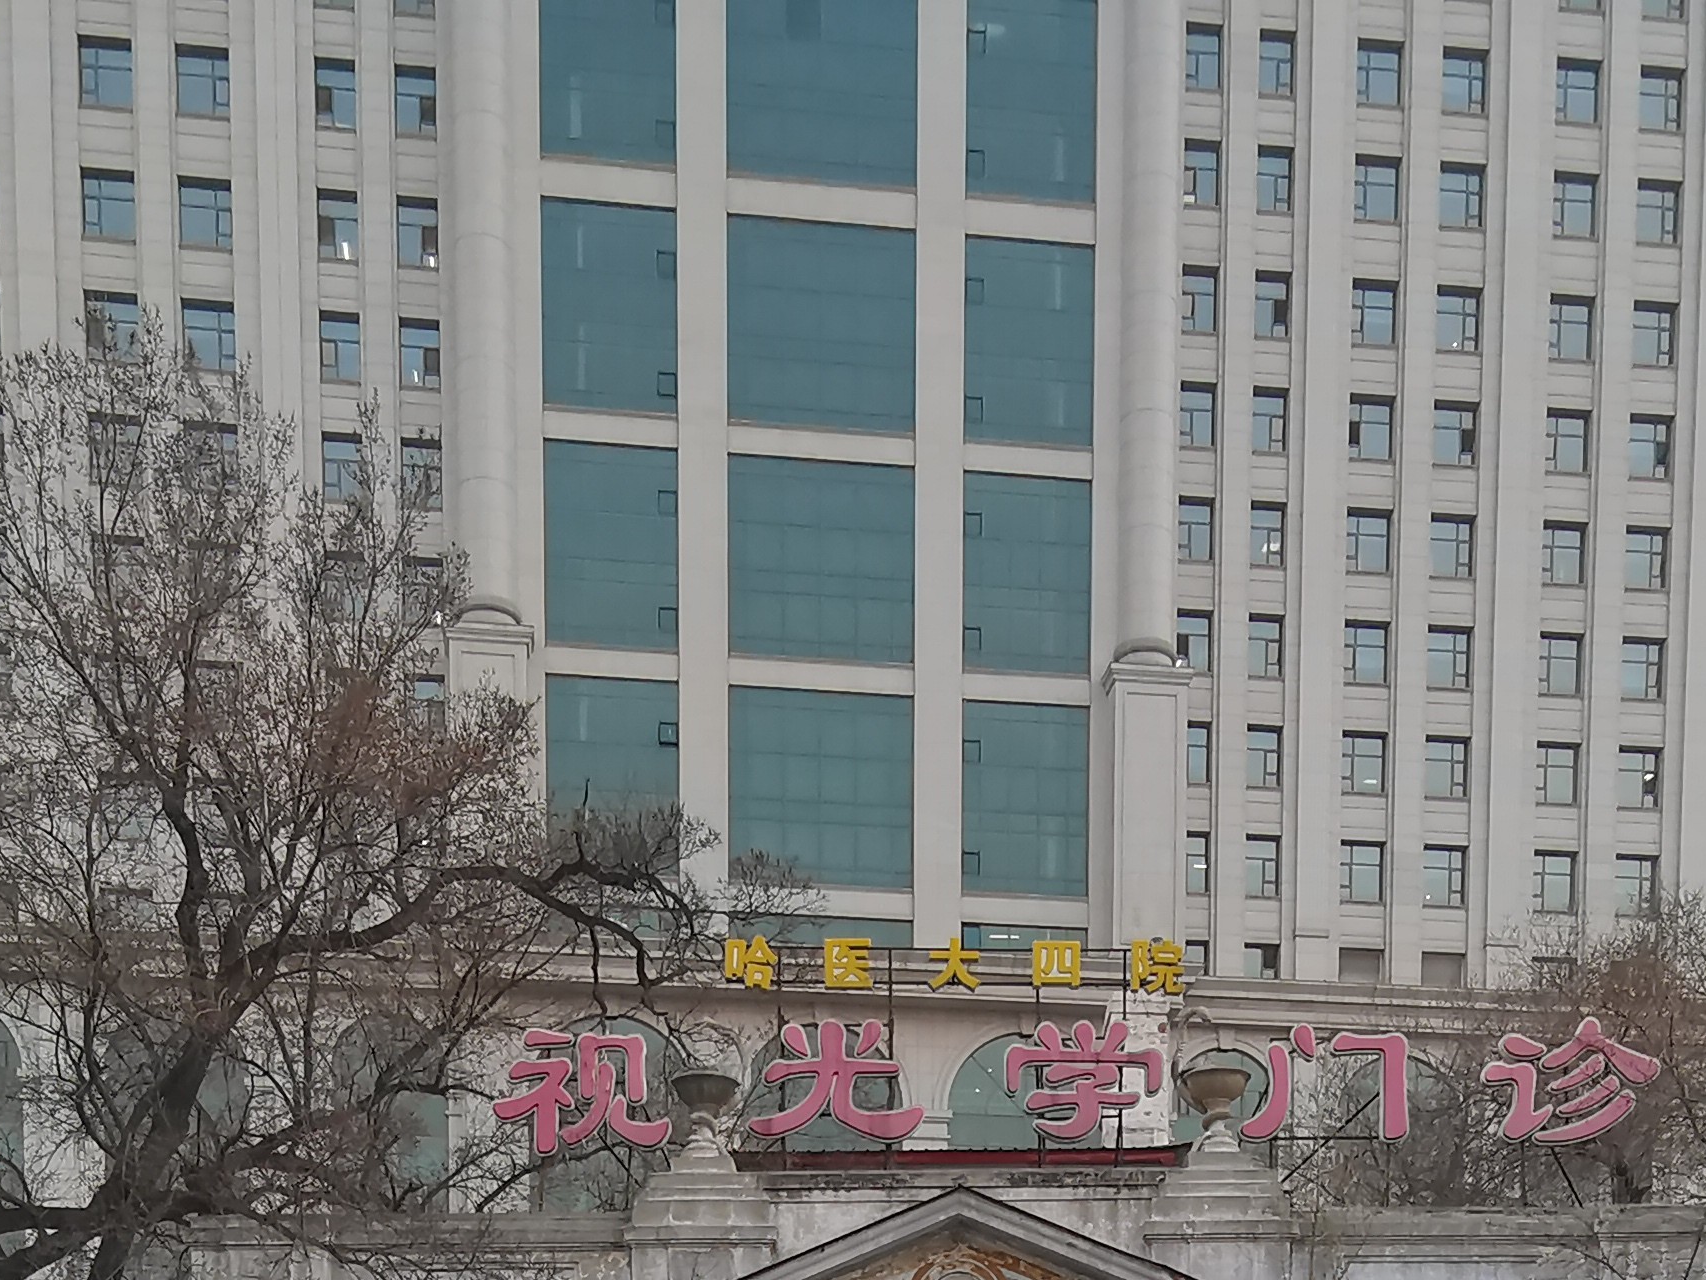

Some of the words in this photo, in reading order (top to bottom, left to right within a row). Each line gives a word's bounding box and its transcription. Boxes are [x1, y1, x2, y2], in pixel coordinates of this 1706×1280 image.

[724, 935, 1187, 995] 哈医大四院
[493, 1018, 1662, 1156] 视光学门诊
